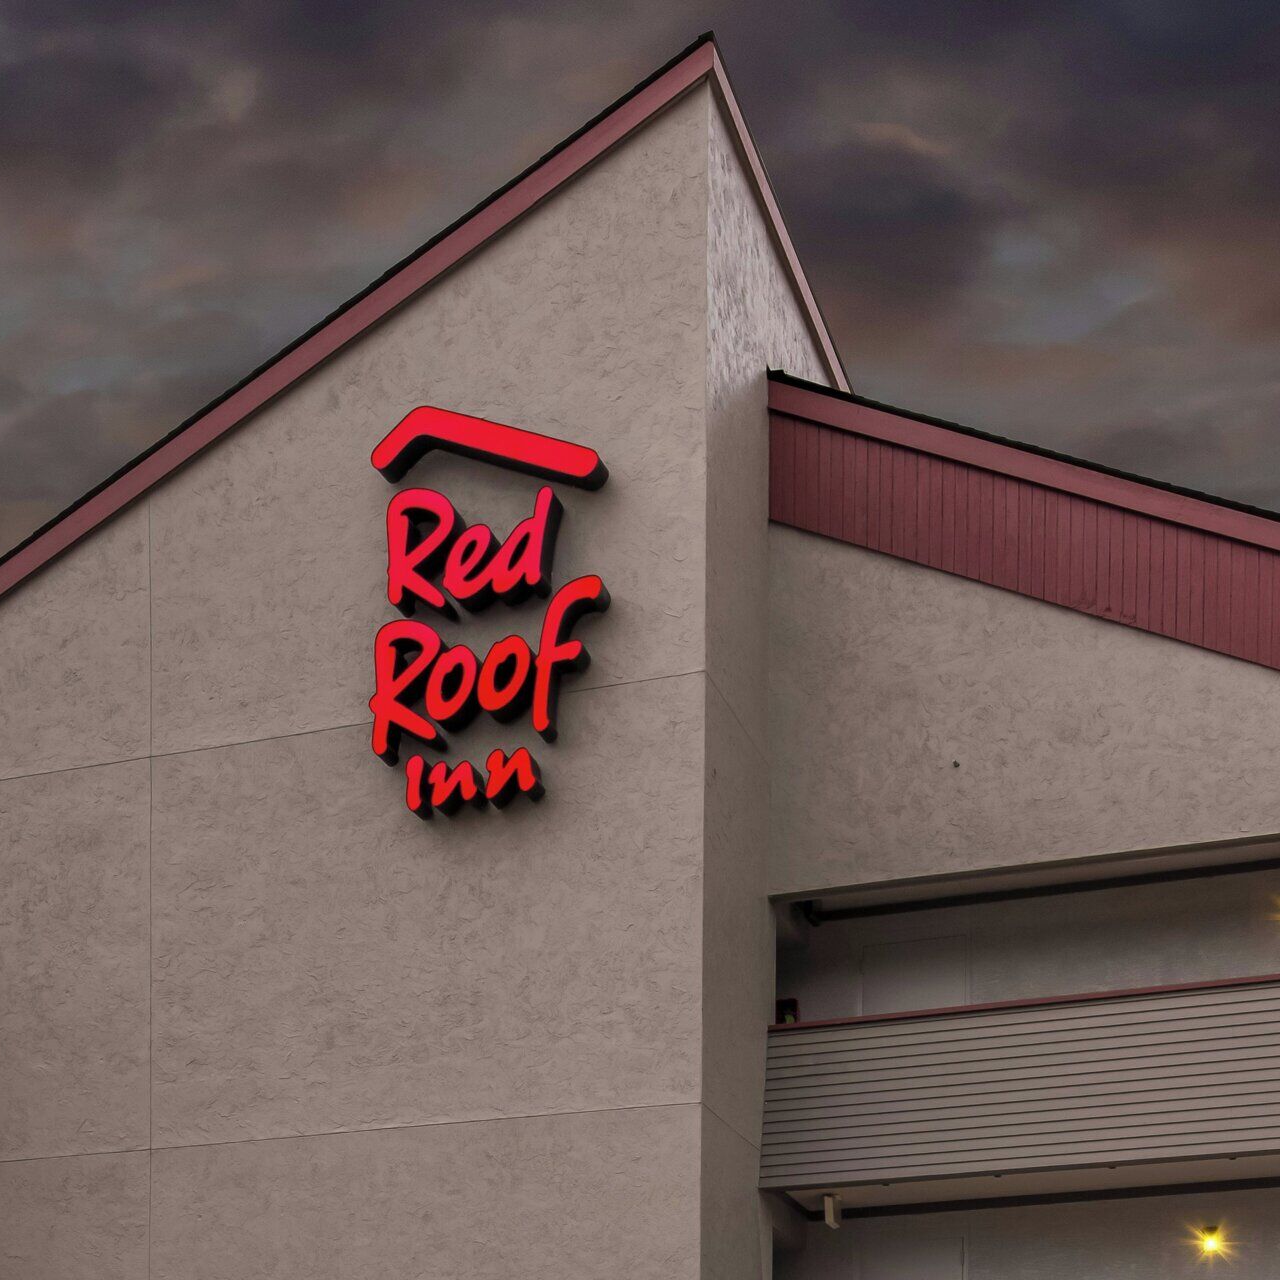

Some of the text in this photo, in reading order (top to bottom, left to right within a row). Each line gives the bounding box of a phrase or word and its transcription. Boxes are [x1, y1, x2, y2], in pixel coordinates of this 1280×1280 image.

[387, 486, 557, 610] Red
[369, 575, 604, 756] Roof
[405, 747, 539, 813] Inn
